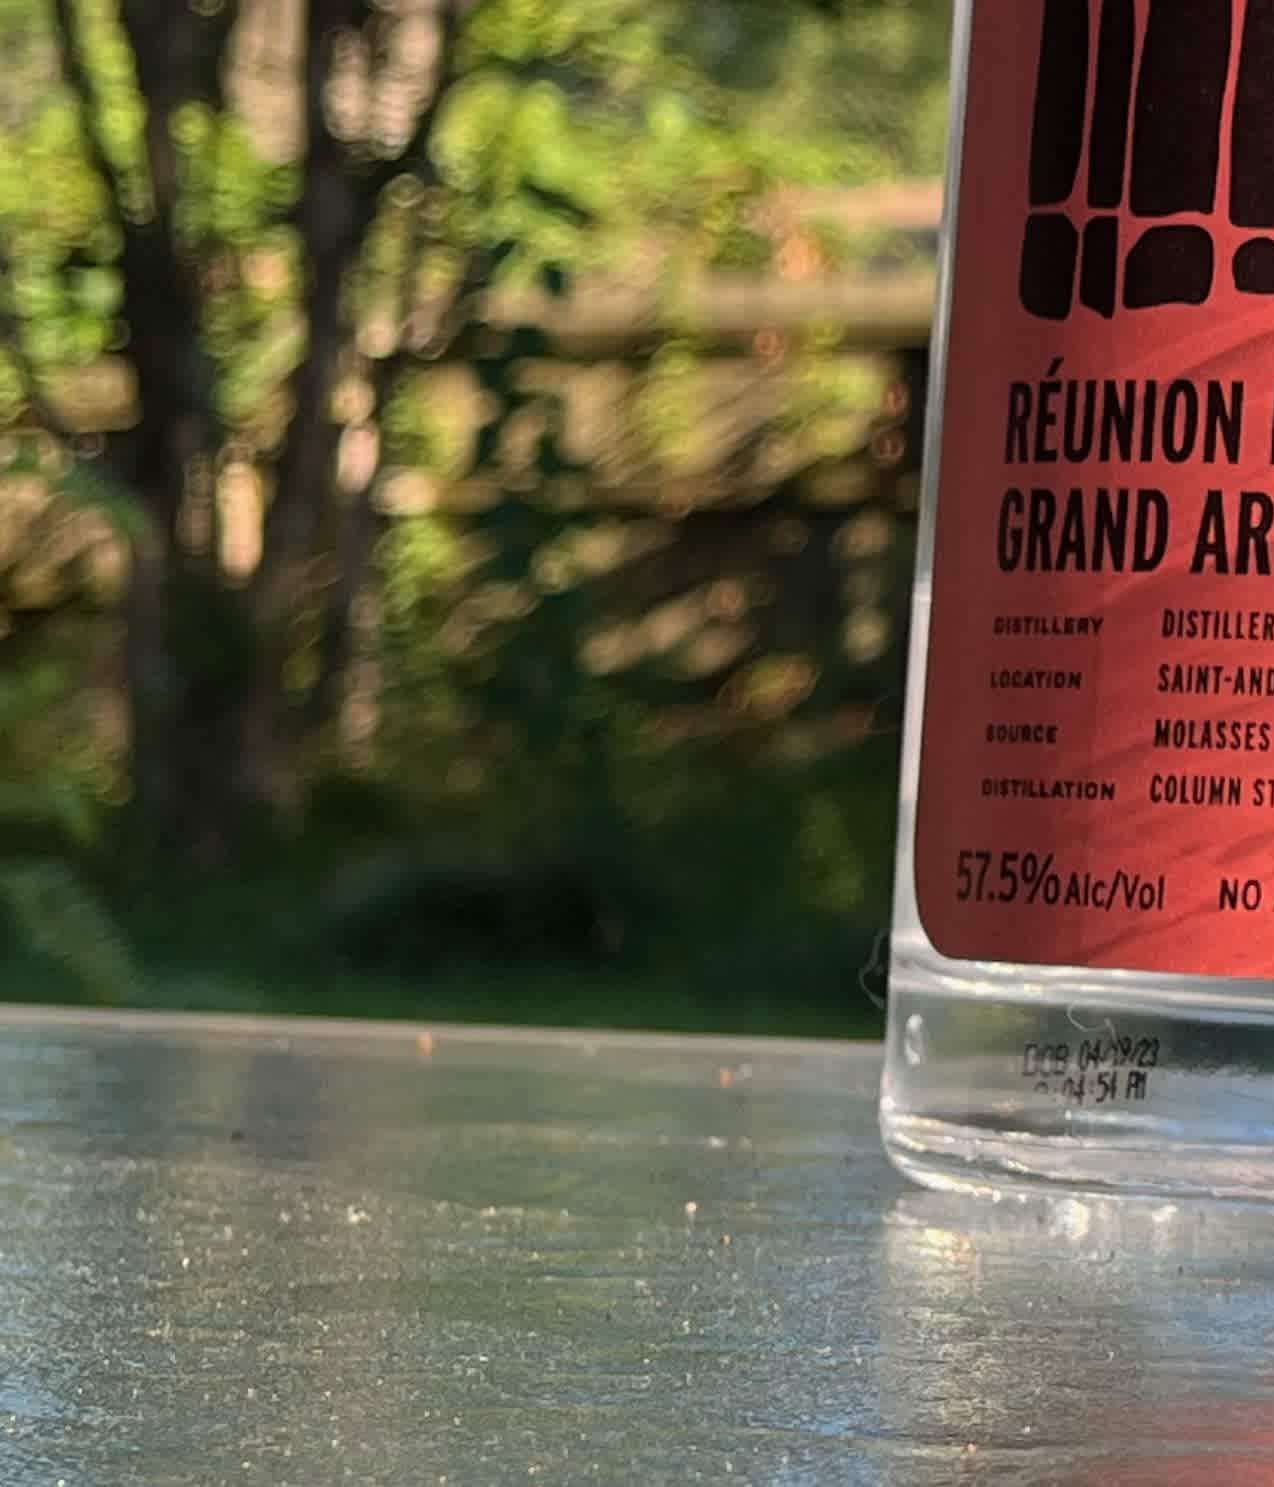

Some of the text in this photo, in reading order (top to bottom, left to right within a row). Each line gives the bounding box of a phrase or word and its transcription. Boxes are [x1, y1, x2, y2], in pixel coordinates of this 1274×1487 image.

[1004, 357, 1245, 466] RÉUNION
[997, 486, 1170, 573] GRAND
[993, 615, 1105, 638] DISTILLERY
[990, 669, 1083, 690] LOCATION
[986, 719, 1272, 753] SOURCE MOLASSES
[981, 778, 1116, 802] DISTILLATION
[1149, 774, 1242, 808] COLUMN
[1218, 878, 1263, 912] NO
